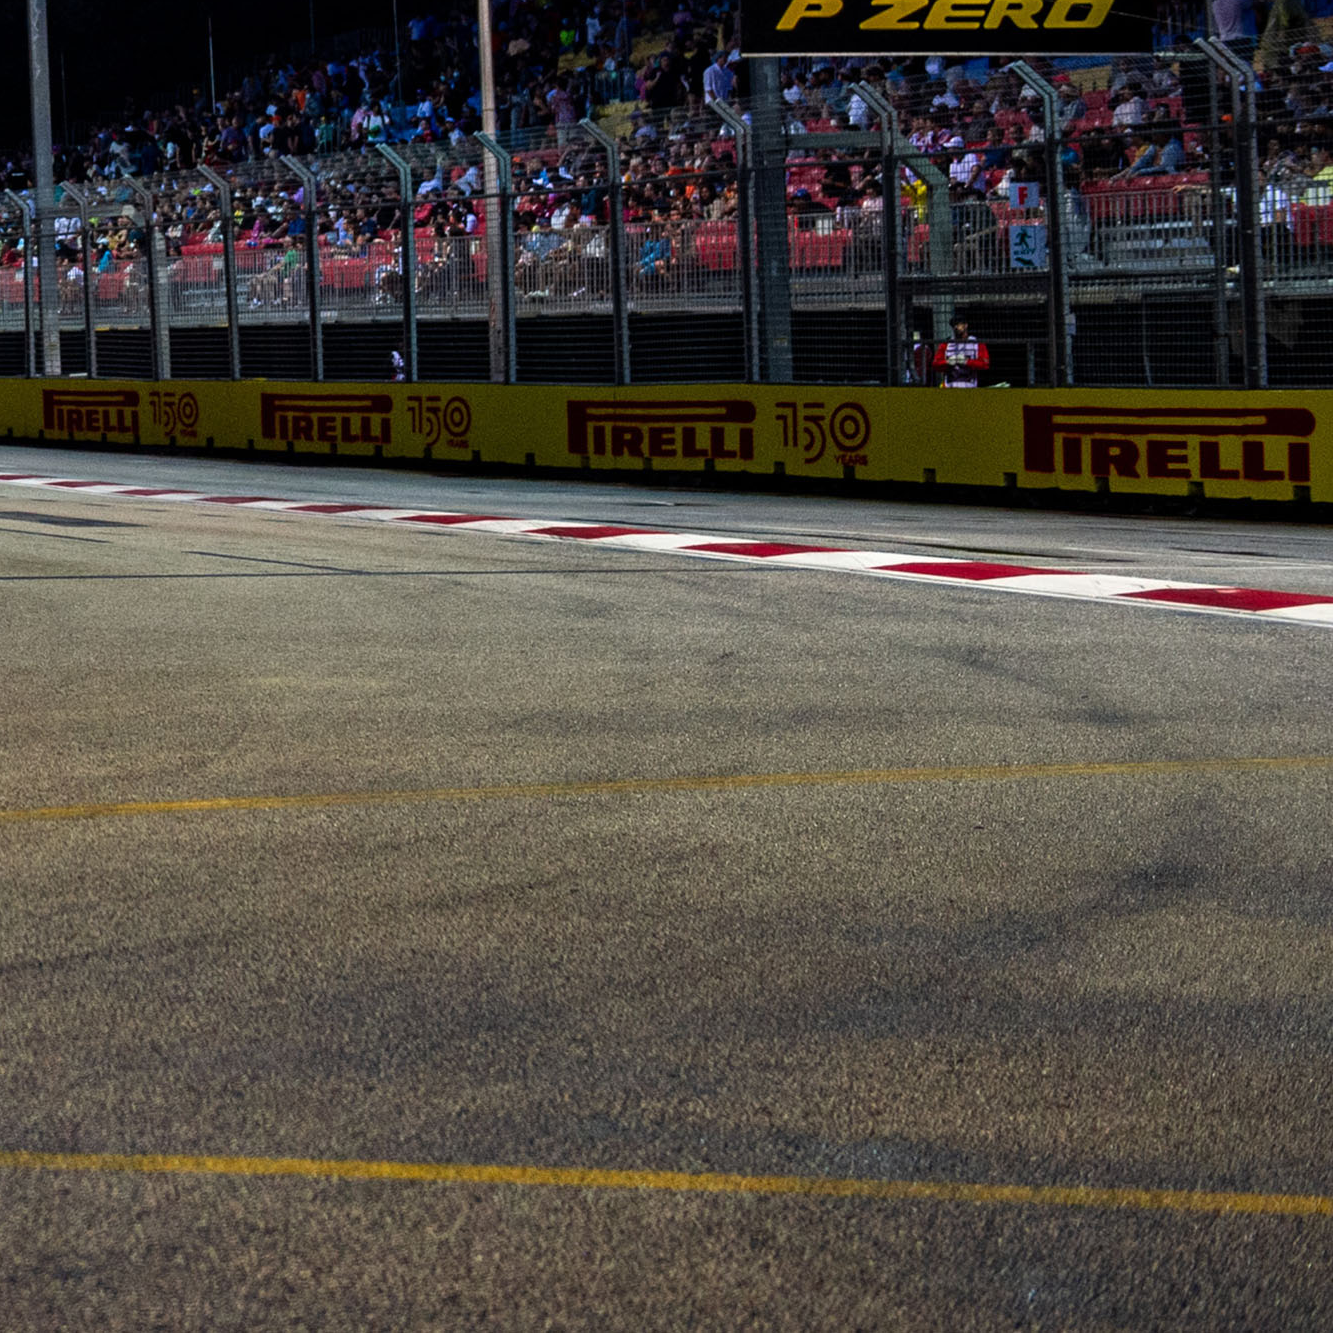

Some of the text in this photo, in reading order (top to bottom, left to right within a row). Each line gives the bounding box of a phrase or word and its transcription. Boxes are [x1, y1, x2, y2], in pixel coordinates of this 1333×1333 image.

[1018, 186, 1028, 205] F
[42, 389, 199, 436] PIRELLI 150
[261, 392, 472, 447] PIRELLI 150
[567, 400, 871, 464] PIRELLI 150
[1023, 404, 1316, 481] PIRELLI
